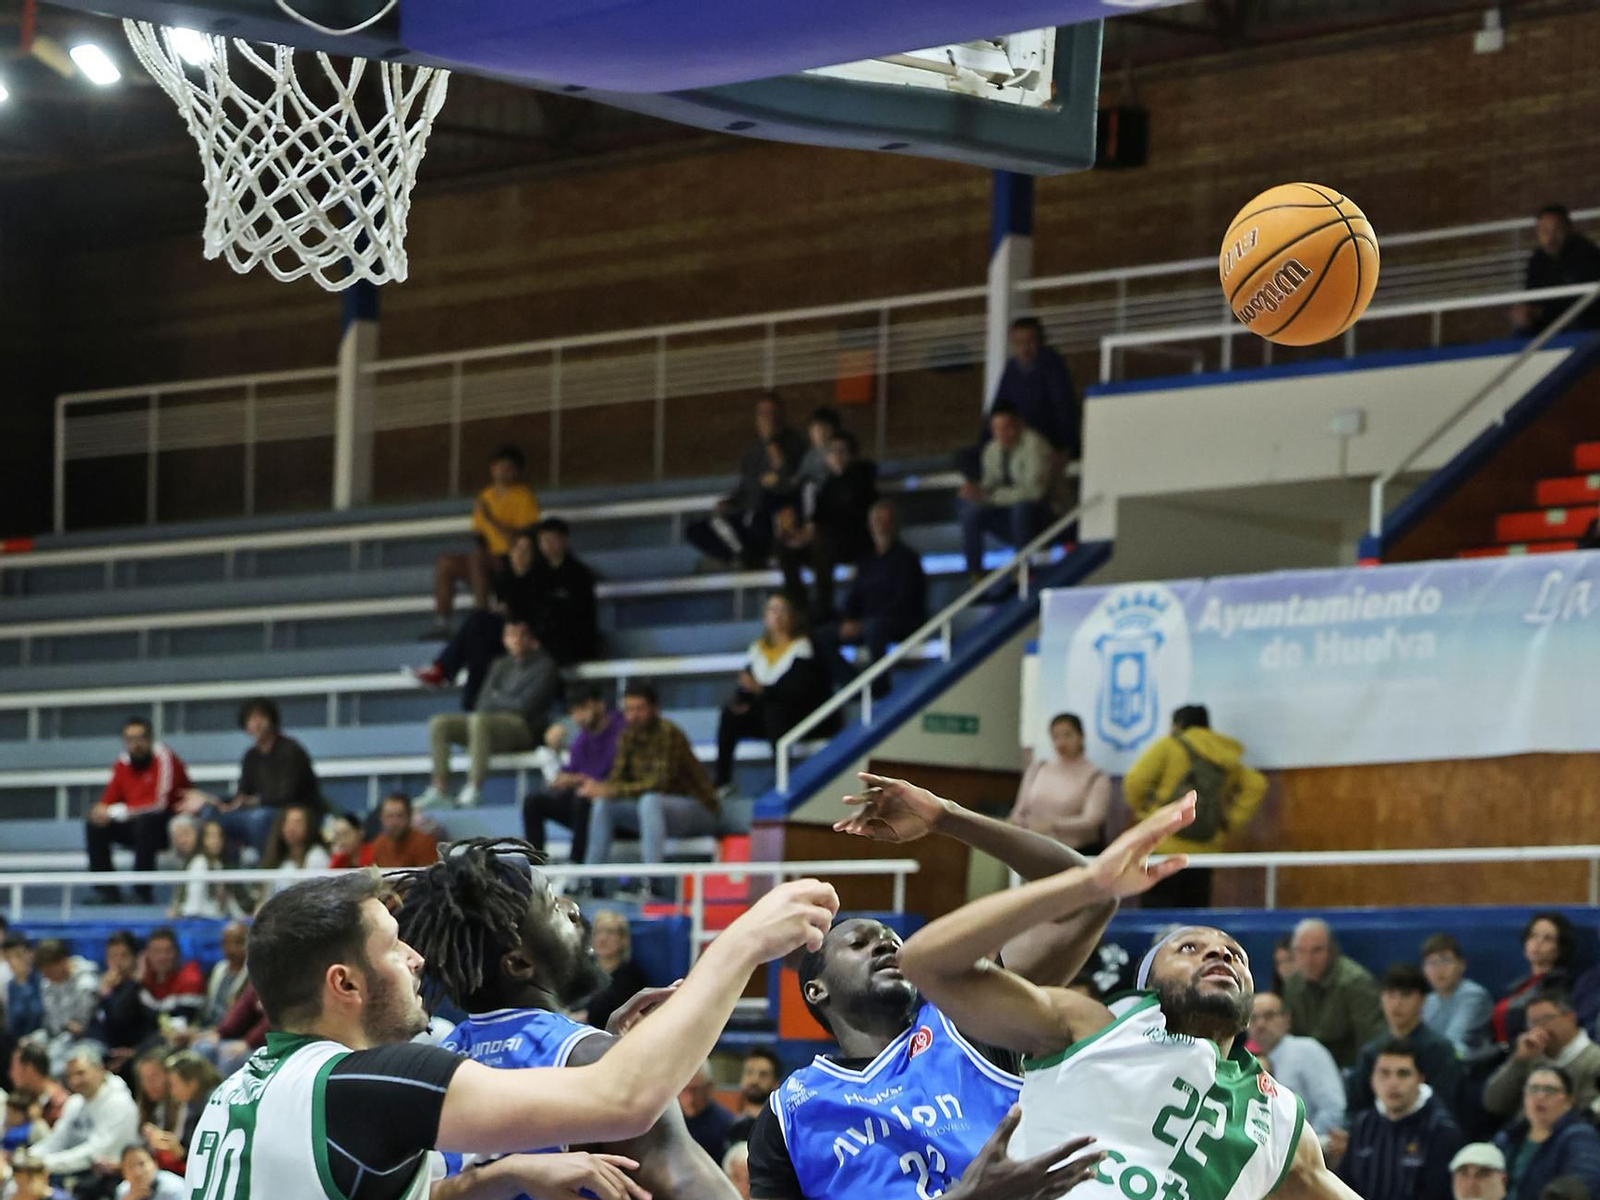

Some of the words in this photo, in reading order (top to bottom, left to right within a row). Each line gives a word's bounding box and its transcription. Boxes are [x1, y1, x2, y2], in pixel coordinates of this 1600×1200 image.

[1238, 258, 1313, 325] Wilson
[1198, 581, 1442, 639] Ayuntamiento
[1260, 636, 1304, 669] de
[1315, 627, 1436, 665] Huelva
[1152, 1077, 1227, 1167] 22
